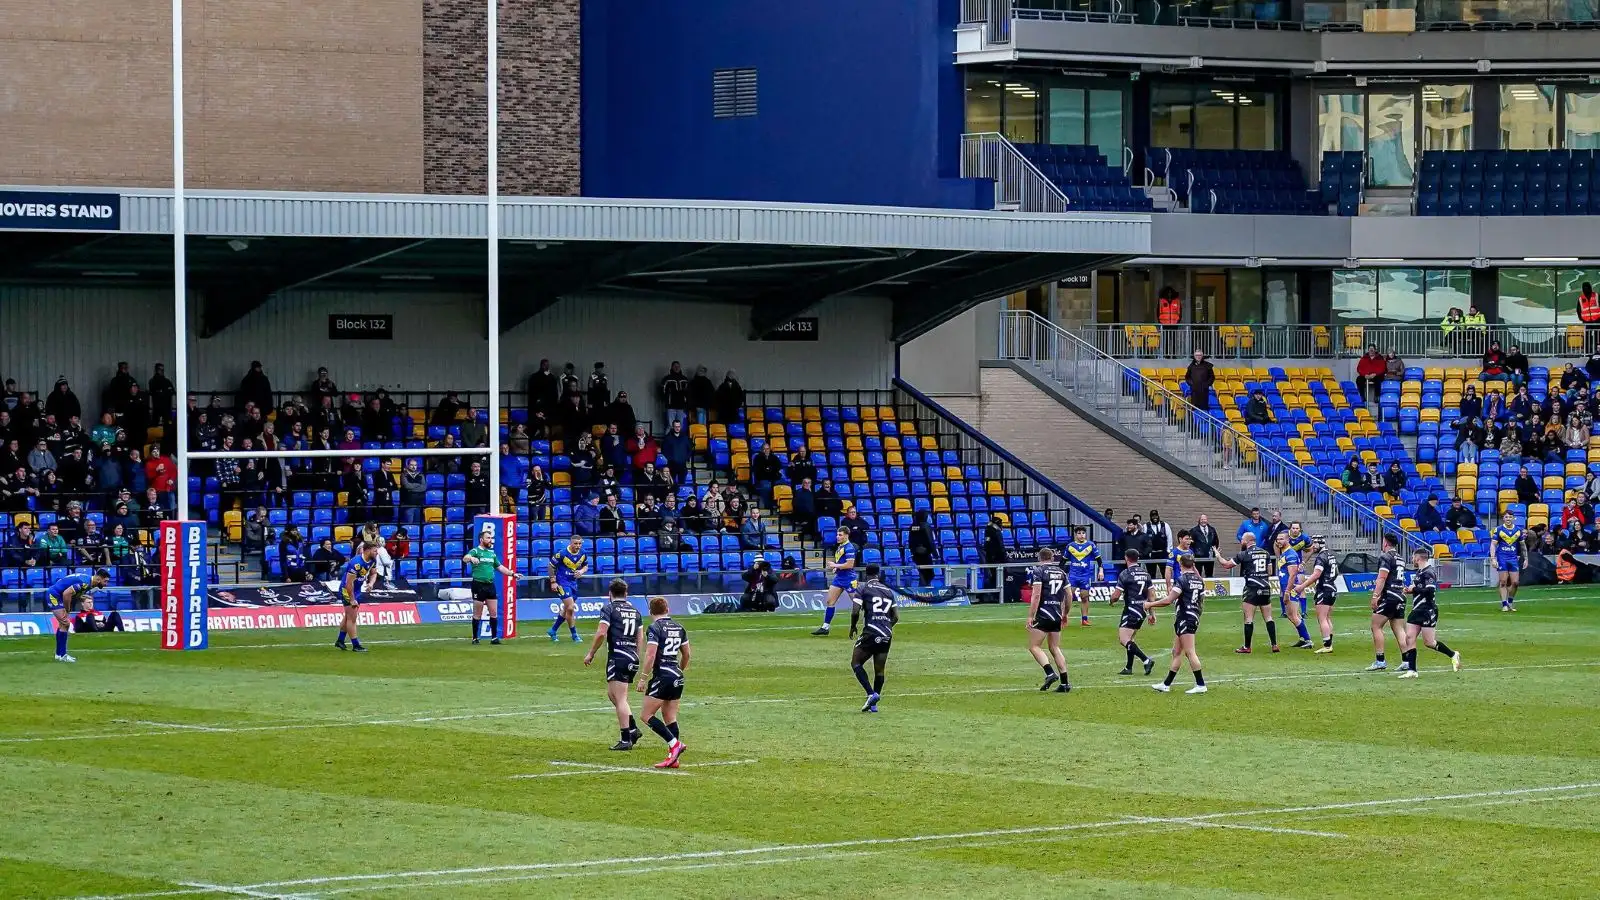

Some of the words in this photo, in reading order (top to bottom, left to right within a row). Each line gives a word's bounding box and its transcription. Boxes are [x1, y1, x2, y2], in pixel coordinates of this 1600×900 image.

[0, 203, 56, 217] OVERS
[60, 204, 113, 218] STAND
[336, 319, 367, 329] Block
[370, 319, 386, 329] 132
[775, 321, 795, 331] ock
[797, 321, 812, 331] 133
[1253, 559, 1266, 573] 19
[165, 527, 178, 647] BETFRED
[188, 526, 202, 647] BETFRED
[1049, 580, 1063, 595] 17
[1137, 581, 1146, 596] 7
[437, 603, 473, 614] CAP
[871, 596, 893, 614] 27
[622, 618, 636, 636] 11
[662, 638, 682, 656] 22
